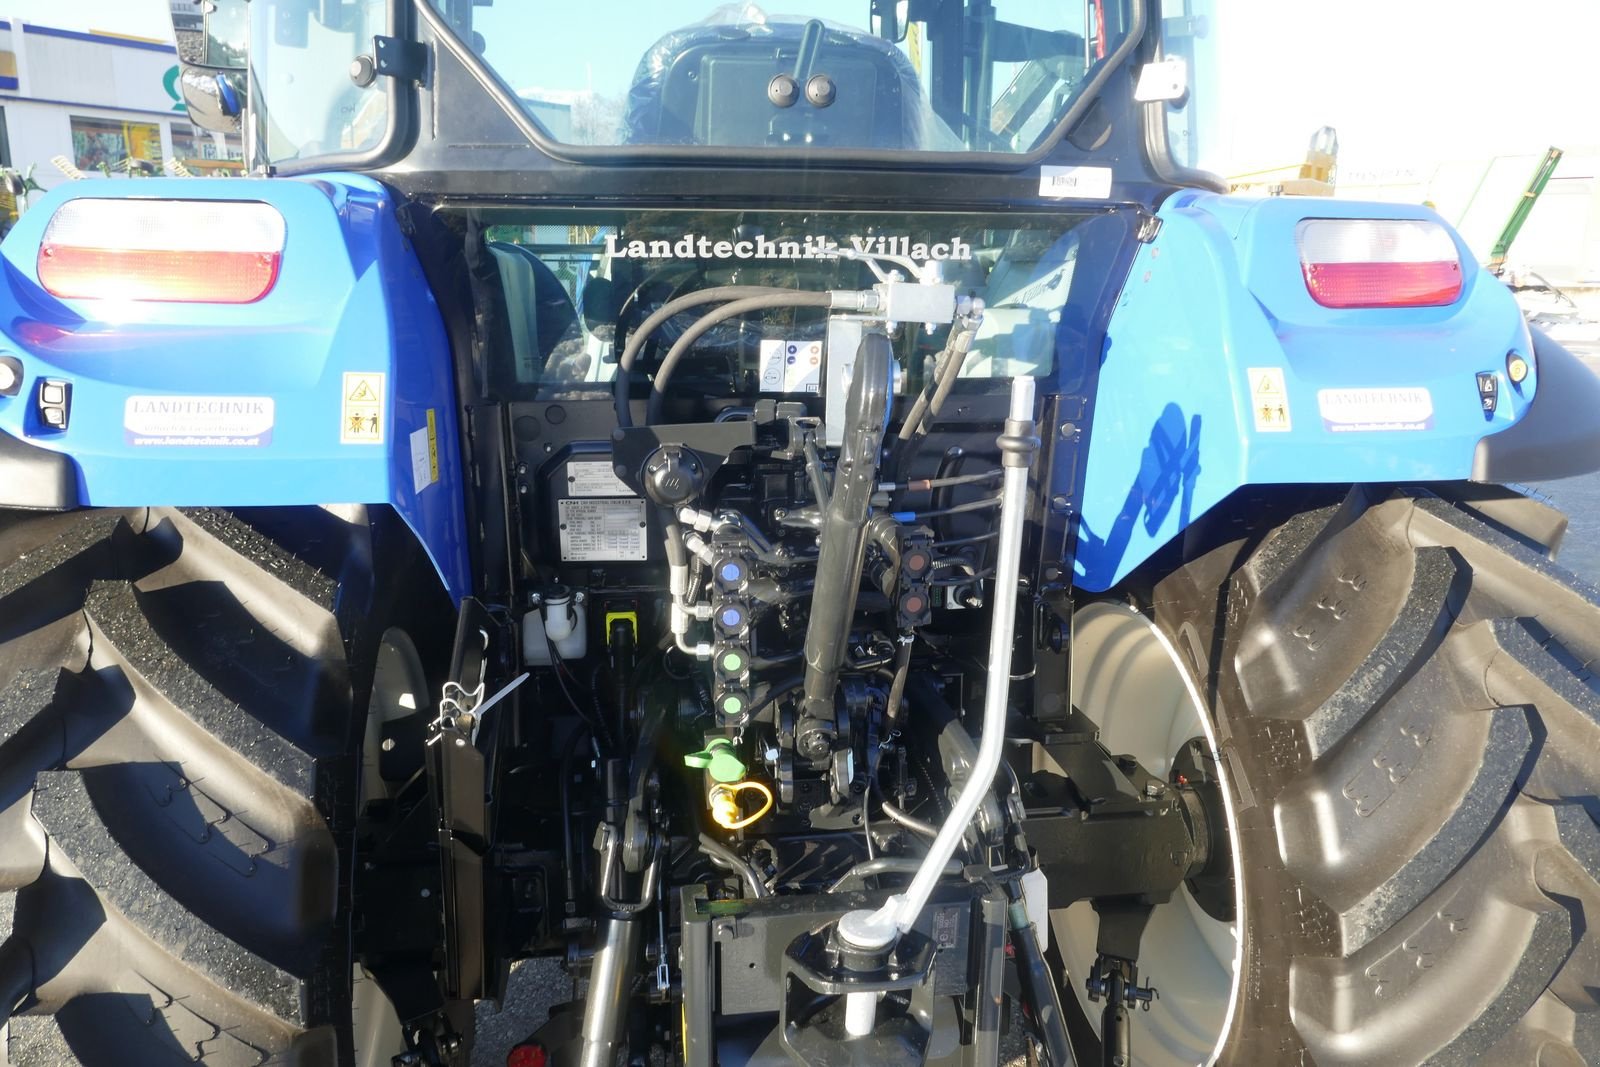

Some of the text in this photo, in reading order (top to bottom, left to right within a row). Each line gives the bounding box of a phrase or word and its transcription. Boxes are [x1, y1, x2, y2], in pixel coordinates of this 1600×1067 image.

[1325, 392, 1423, 405] LANDTECHNIK
[133, 401, 264, 414] LANDTECHNIK
[134, 436, 259, 446] www.landtechnik.co.at
